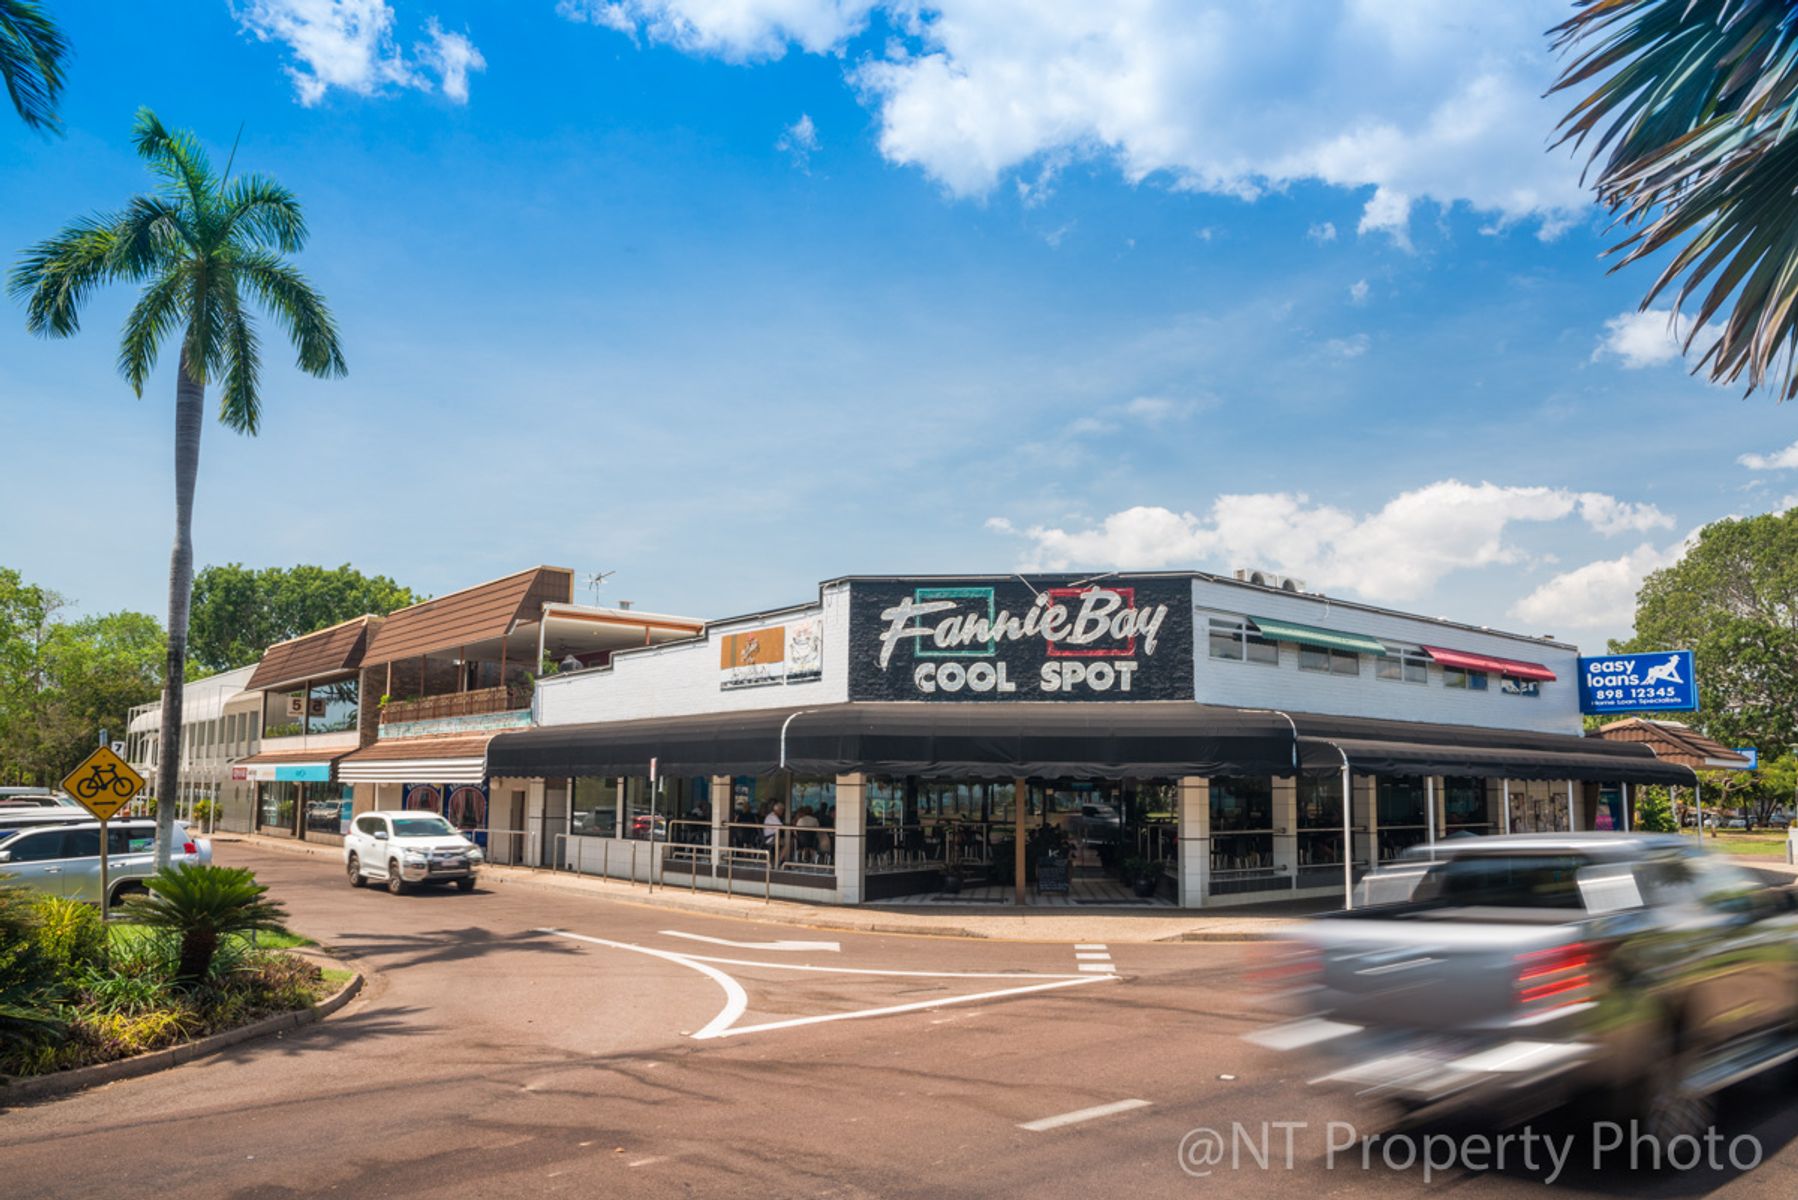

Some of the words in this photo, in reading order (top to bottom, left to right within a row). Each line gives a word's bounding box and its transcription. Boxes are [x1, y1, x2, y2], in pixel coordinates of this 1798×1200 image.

[879, 592, 1072, 671] Fannie
[1066, 585, 1167, 655] Bay
[1589, 660, 1635, 675] easy
[914, 662, 1016, 692] COOL
[1040, 661, 1138, 692] SPOT
[1587, 673, 1639, 687] loans
[1596, 689, 1623, 699] 898
[1630, 686, 1675, 698] 12345
[292, 699, 301, 710] 5
